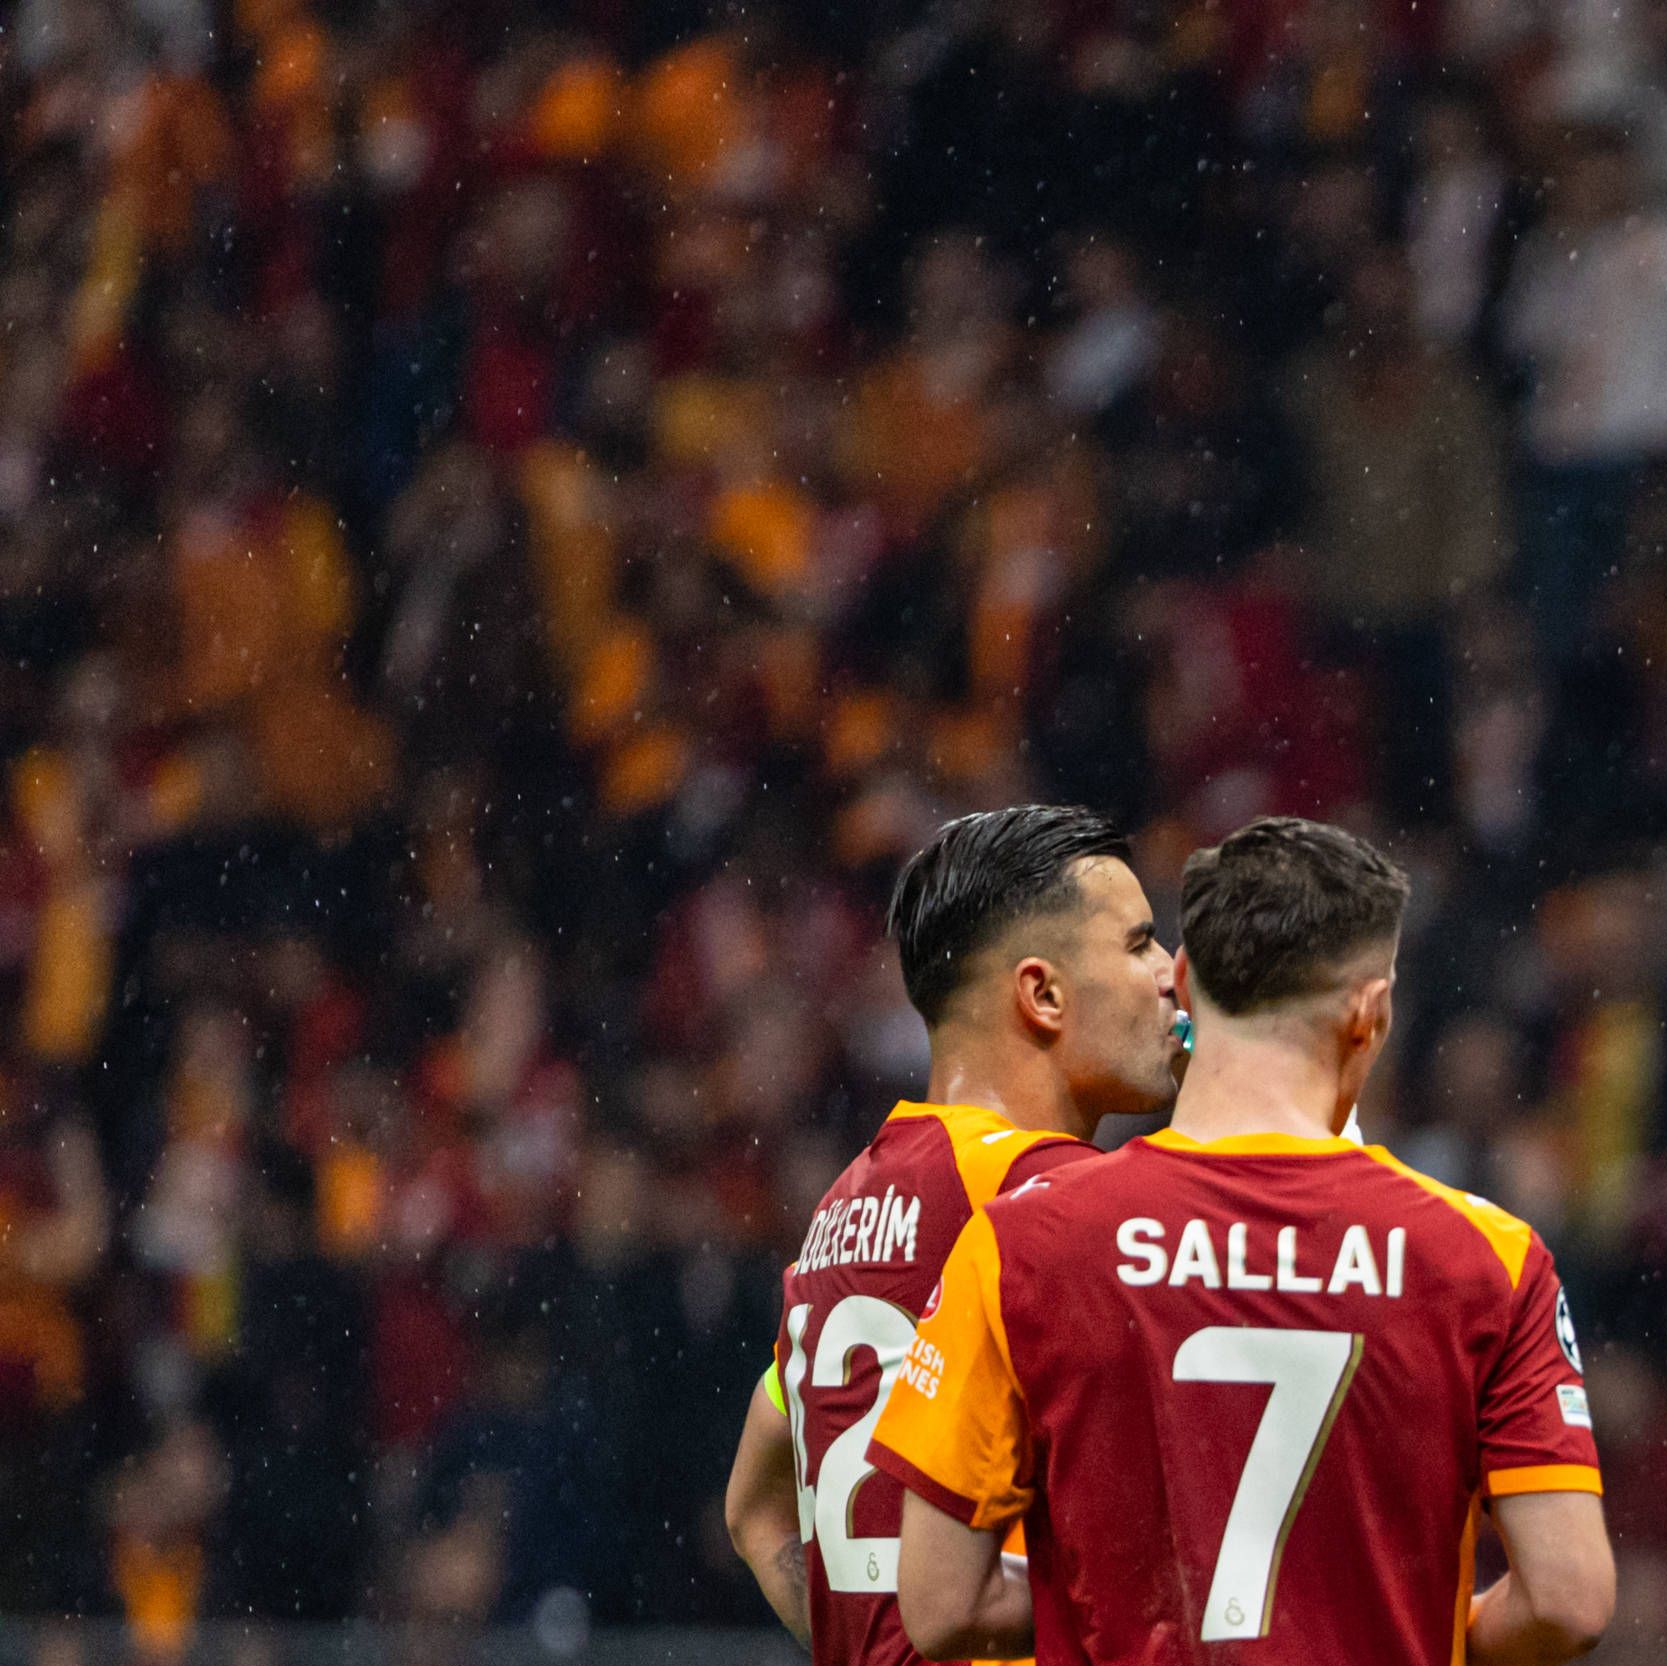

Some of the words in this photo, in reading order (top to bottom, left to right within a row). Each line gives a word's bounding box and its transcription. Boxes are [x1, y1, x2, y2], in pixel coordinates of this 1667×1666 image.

[1116, 1216, 1407, 1298] SALLAI
[784, 1295, 919, 1592] 12
[1172, 1325, 1364, 1642] 7
